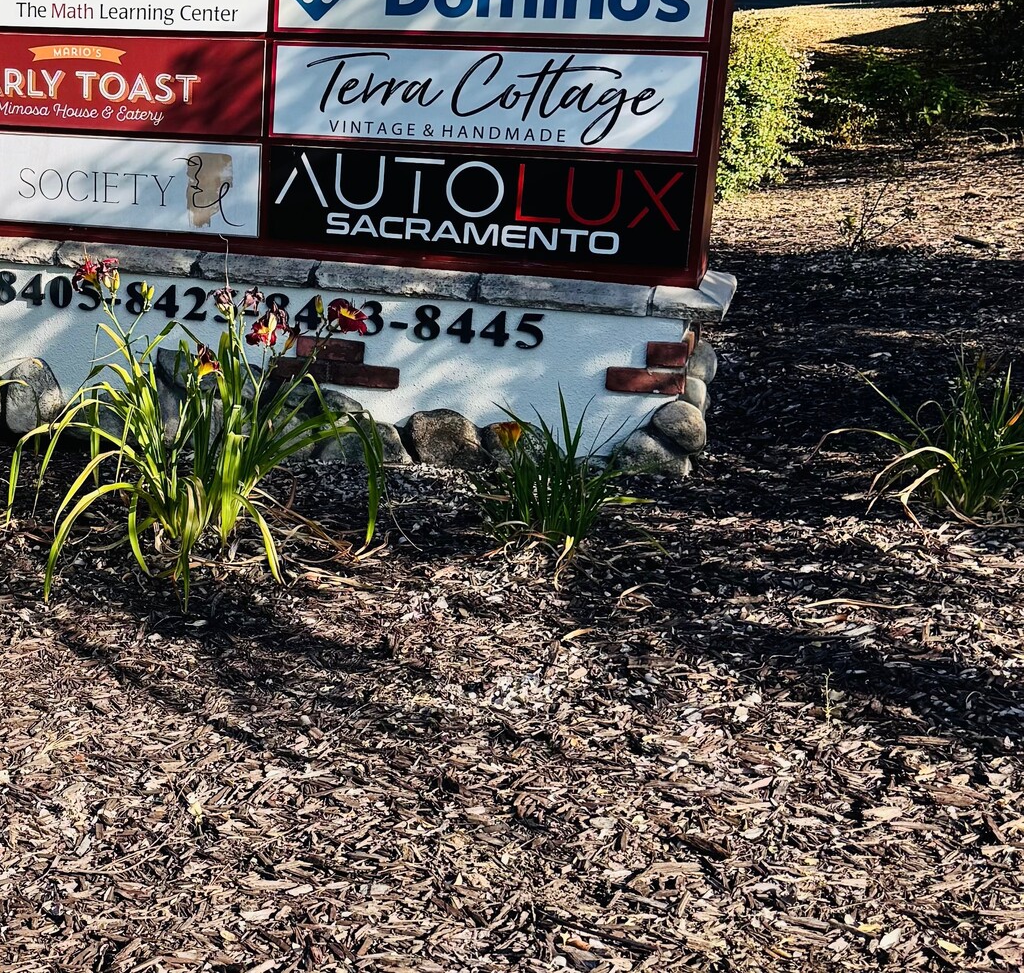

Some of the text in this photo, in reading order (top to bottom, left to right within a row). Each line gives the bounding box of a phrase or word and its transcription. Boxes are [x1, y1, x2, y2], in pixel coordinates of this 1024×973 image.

[16, 2, 239, 25] The Math Learning Center
[52, 46, 103, 59] MARIO'S
[76, 71, 201, 105] TOAST
[306, 51, 665, 146] Terra Cottage
[53, 102, 99, 120] House
[101, 105, 114, 121] &
[116, 105, 164, 126] Eatery
[328, 119, 566, 143] VINTAGE & HANDMADE
[18, 167, 176, 208] SOCIETY
[274, 151, 684, 232] AUTOLUX
[325, 212, 620, 255] SACRAMENTO
